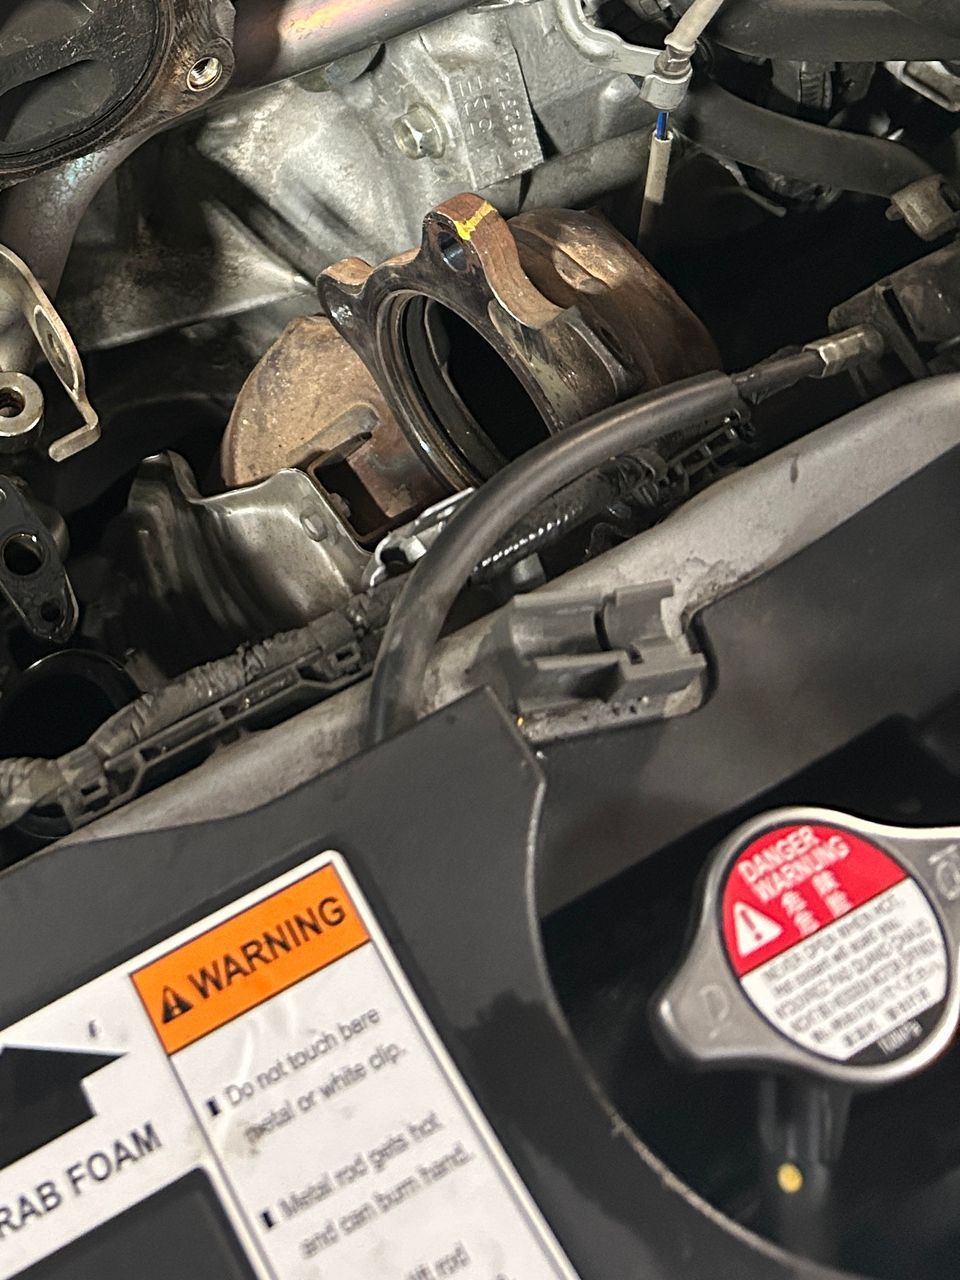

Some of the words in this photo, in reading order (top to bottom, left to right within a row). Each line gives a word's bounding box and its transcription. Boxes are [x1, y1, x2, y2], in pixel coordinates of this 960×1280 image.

[738, 825, 820, 884] DANGER
[187, 896, 347, 1000] WARNING
[225, 1082, 255, 1106] Do
[257, 1059, 289, 1090] not
[286, 1031, 339, 1070] touch
[337, 1008, 381, 1042] bare
[297, 1091, 316, 1112] or
[320, 1062, 368, 1099] white
[65, 1120, 163, 1197] FOAM
[278, 1171, 334, 1217] Metal
[335, 1152, 369, 1187] rod
[368, 1133, 410, 1173] gets
[406, 1110, 443, 1143] hot
[300, 1219, 340, 1260] and
[339, 1201, 379, 1236] can
